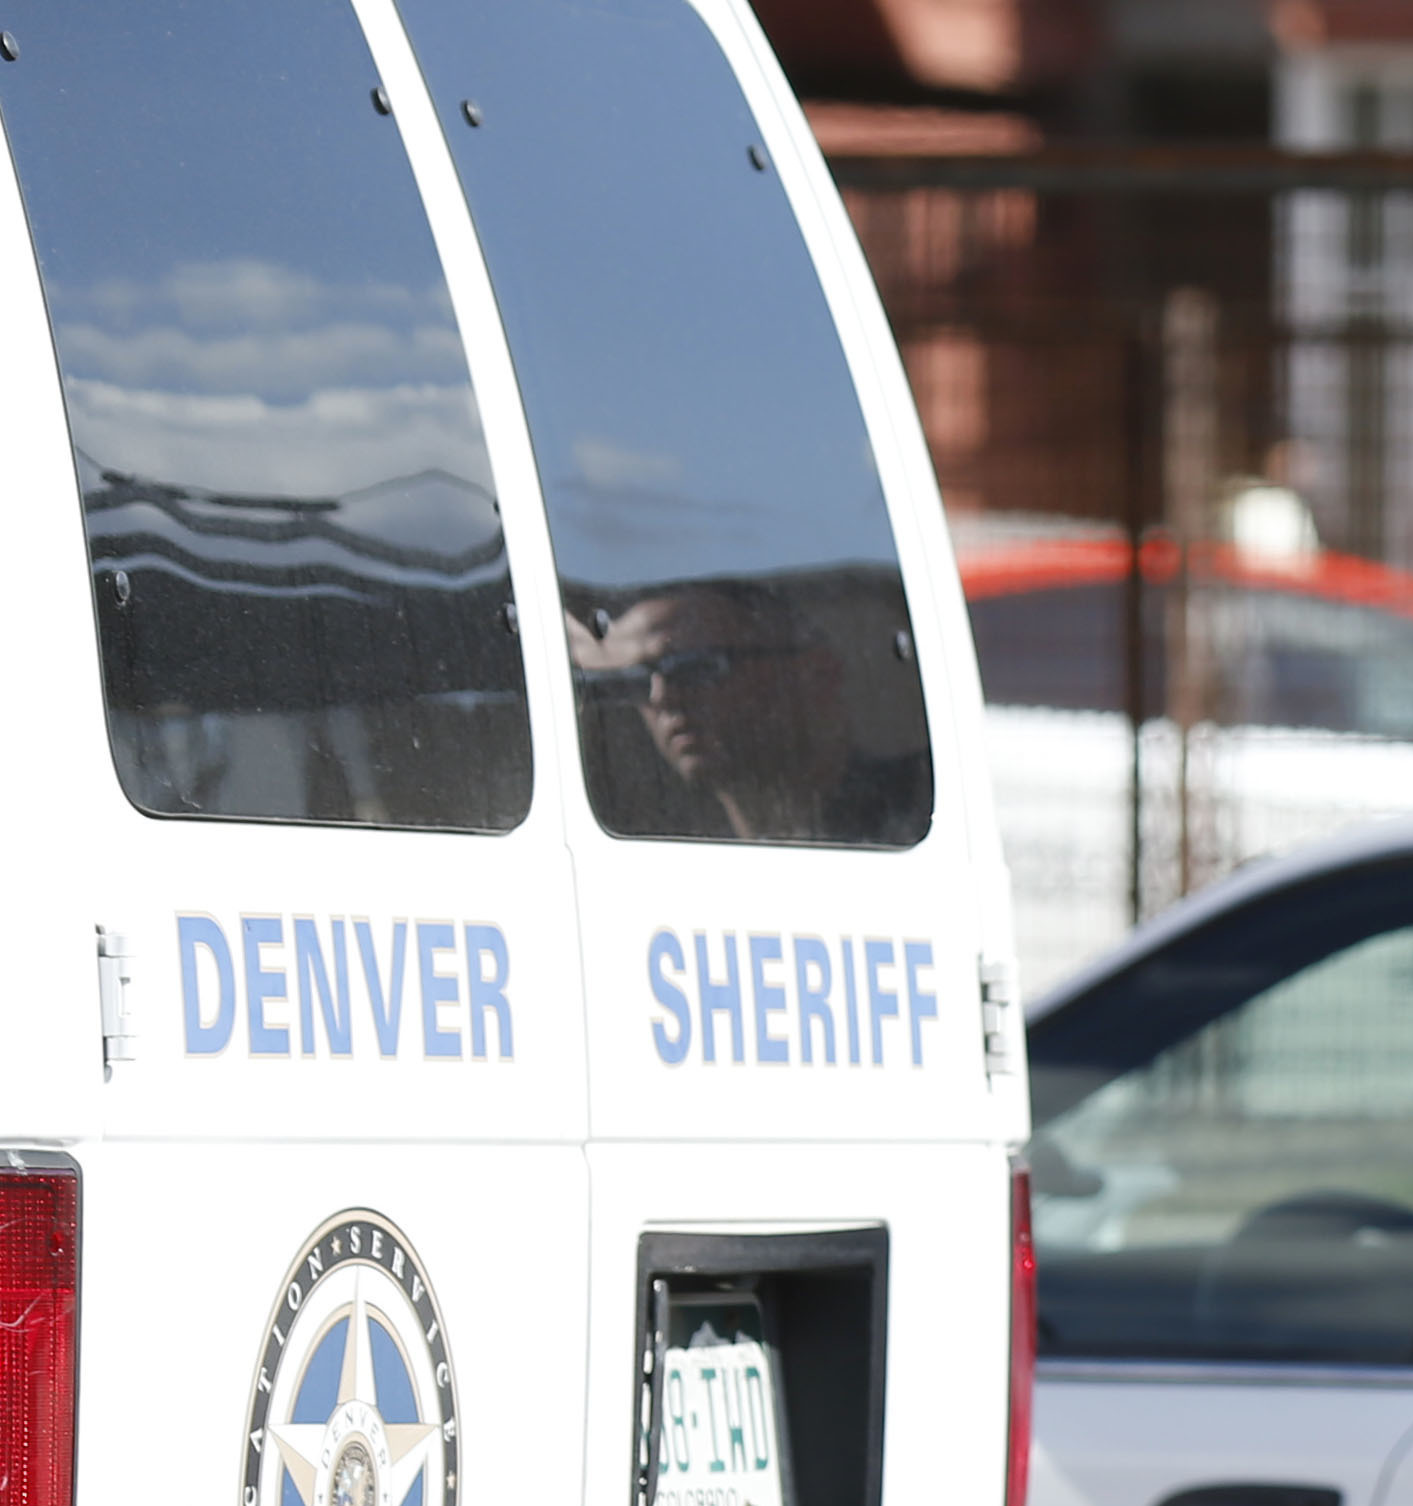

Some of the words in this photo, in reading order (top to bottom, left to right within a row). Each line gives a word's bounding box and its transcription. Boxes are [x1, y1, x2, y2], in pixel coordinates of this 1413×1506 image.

[175, 910, 516, 1062] DENVER
[645, 925, 939, 1069] SHERIFF
[348, 1225, 457, 1443] SERVICE
